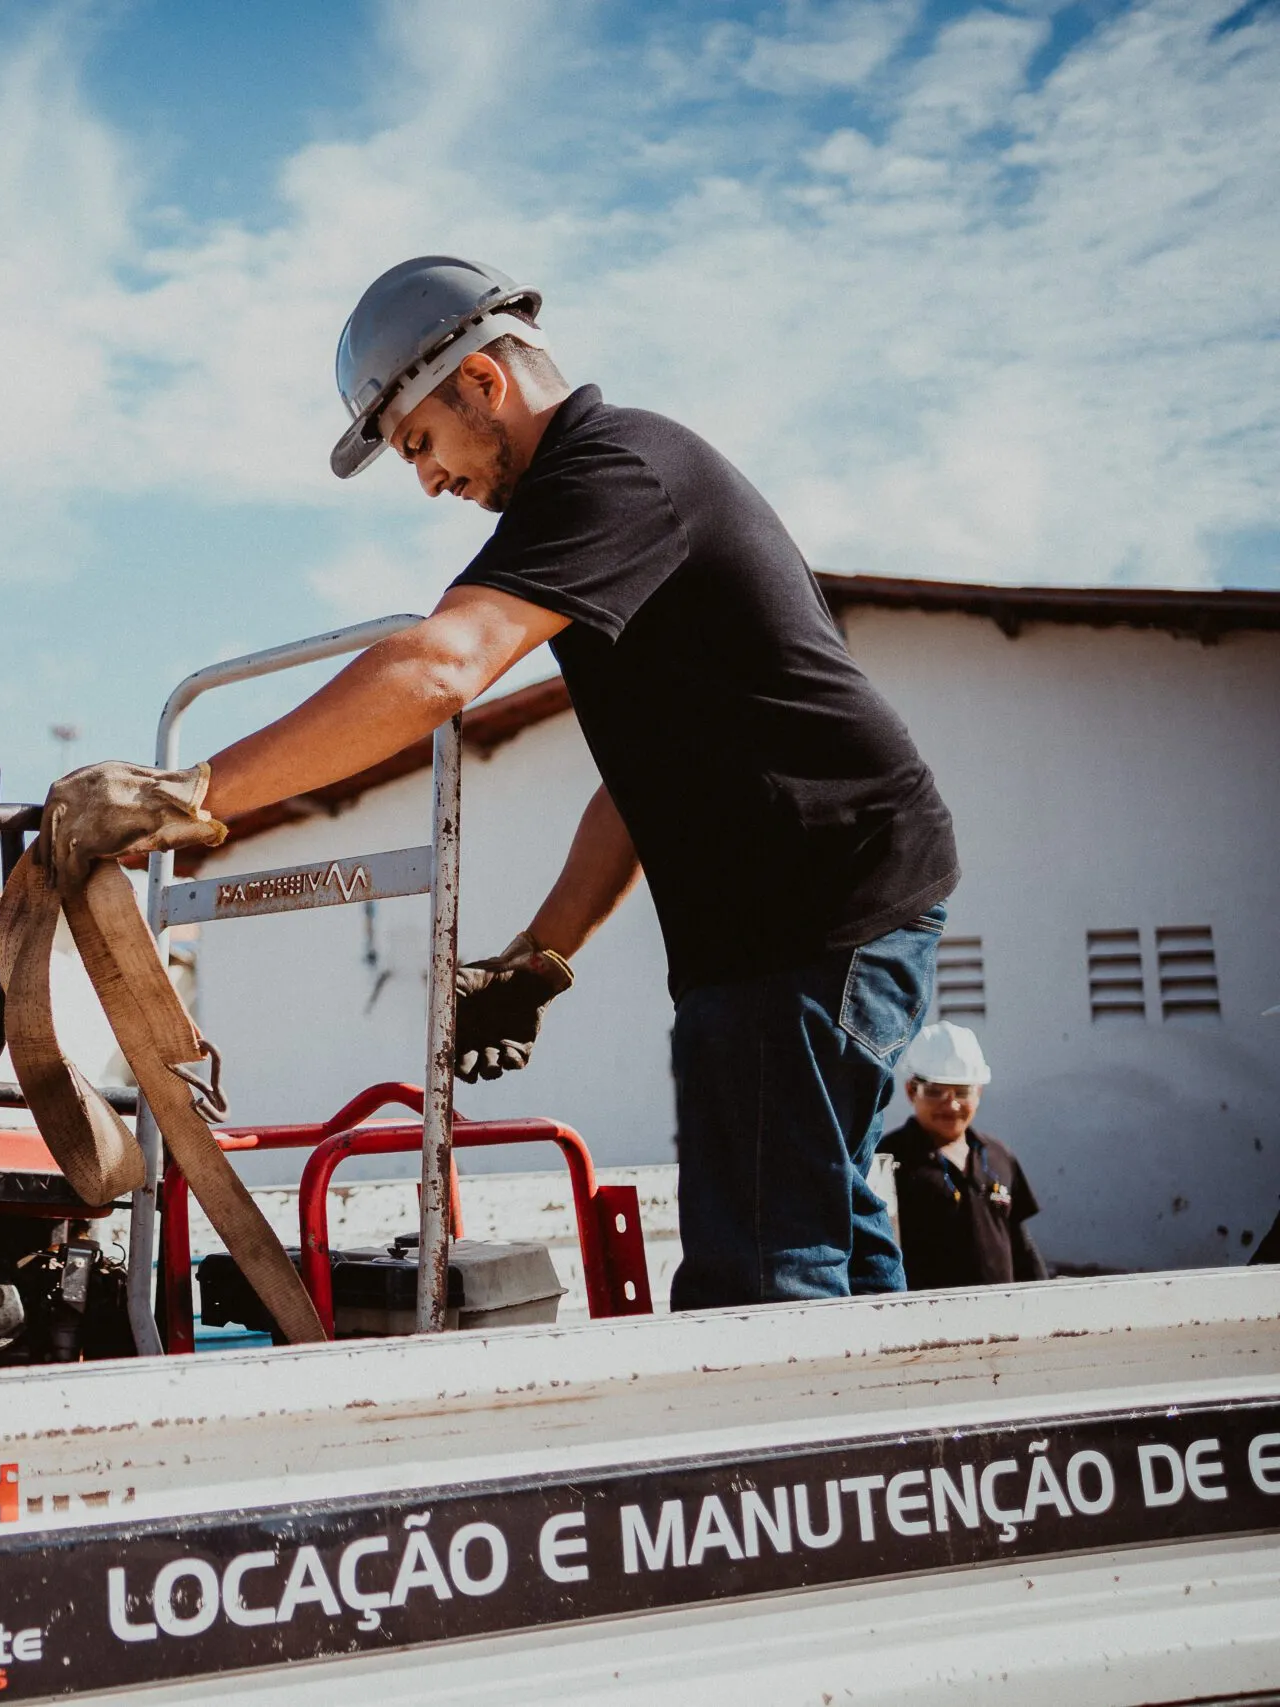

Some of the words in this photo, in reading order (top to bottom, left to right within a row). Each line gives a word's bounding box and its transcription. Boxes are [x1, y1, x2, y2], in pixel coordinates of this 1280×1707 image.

[107, 1511, 509, 1642] LOCAÇÃO
[539, 1511, 590, 1584] E
[620, 1438, 1115, 1575] MANUTENÇÃO
[1137, 1438, 1229, 1509] DE
